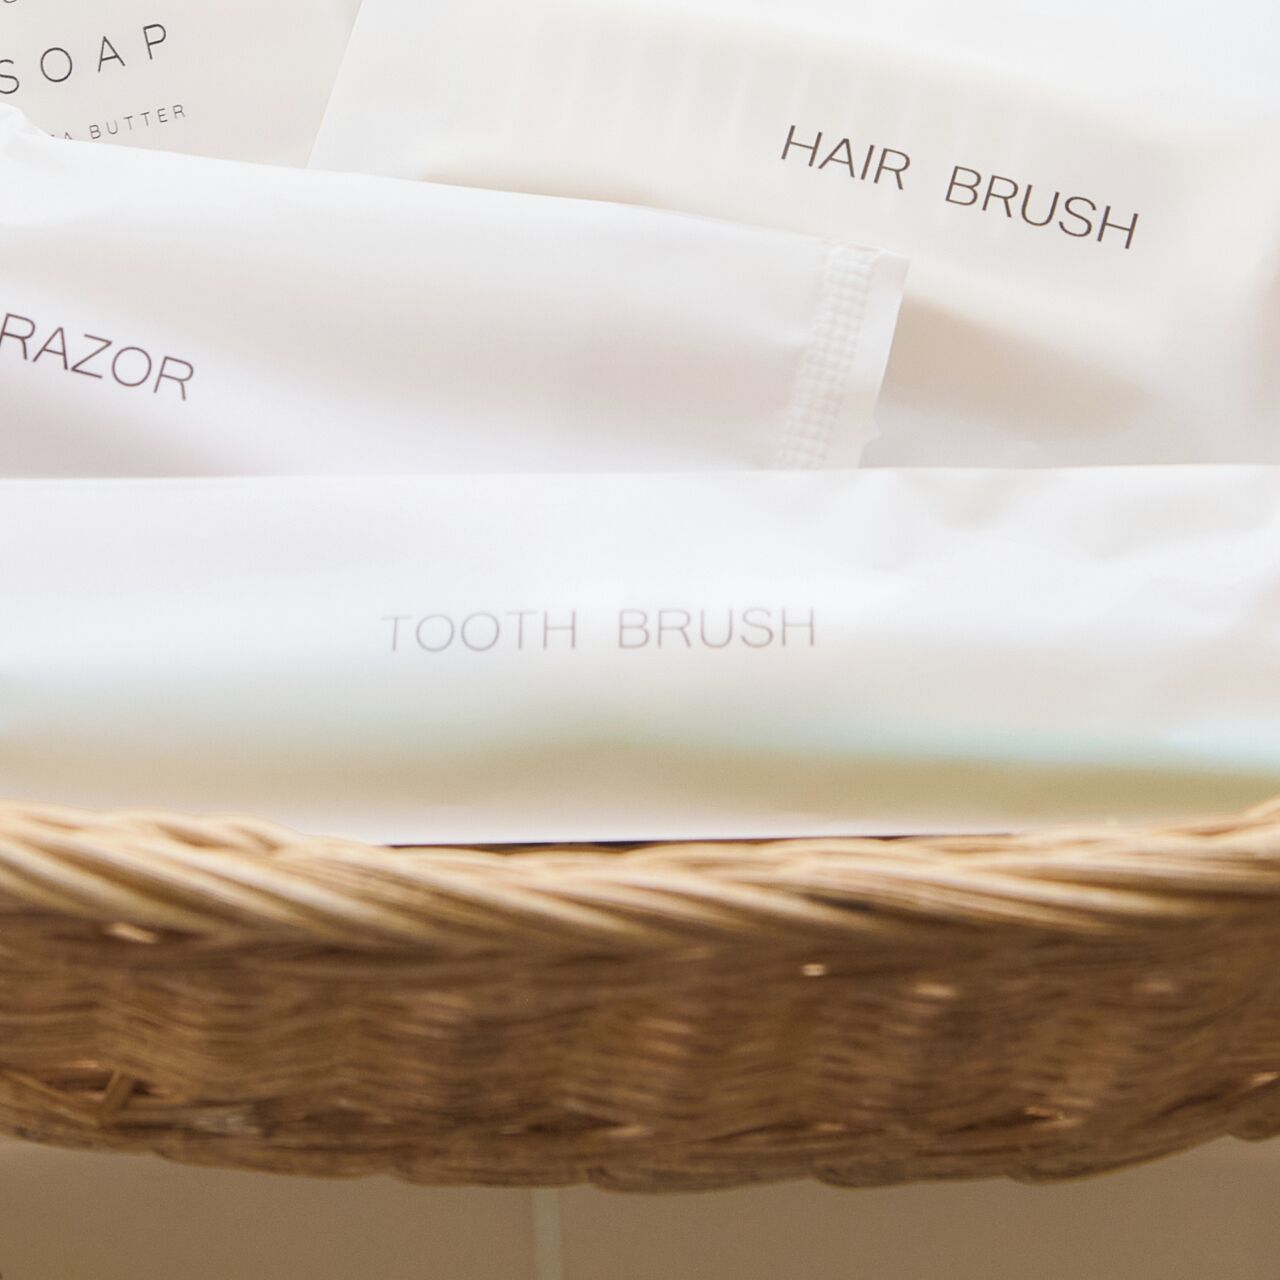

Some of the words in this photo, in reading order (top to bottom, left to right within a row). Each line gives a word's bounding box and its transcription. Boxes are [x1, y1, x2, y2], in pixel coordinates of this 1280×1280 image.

[88, 103, 186, 140] BUTTER
[780, 124, 912, 191] HAIR
[945, 165, 1140, 250] BRUSH
[380, 608, 578, 653] TOOTH
[617, 605, 816, 651] BRUSH
